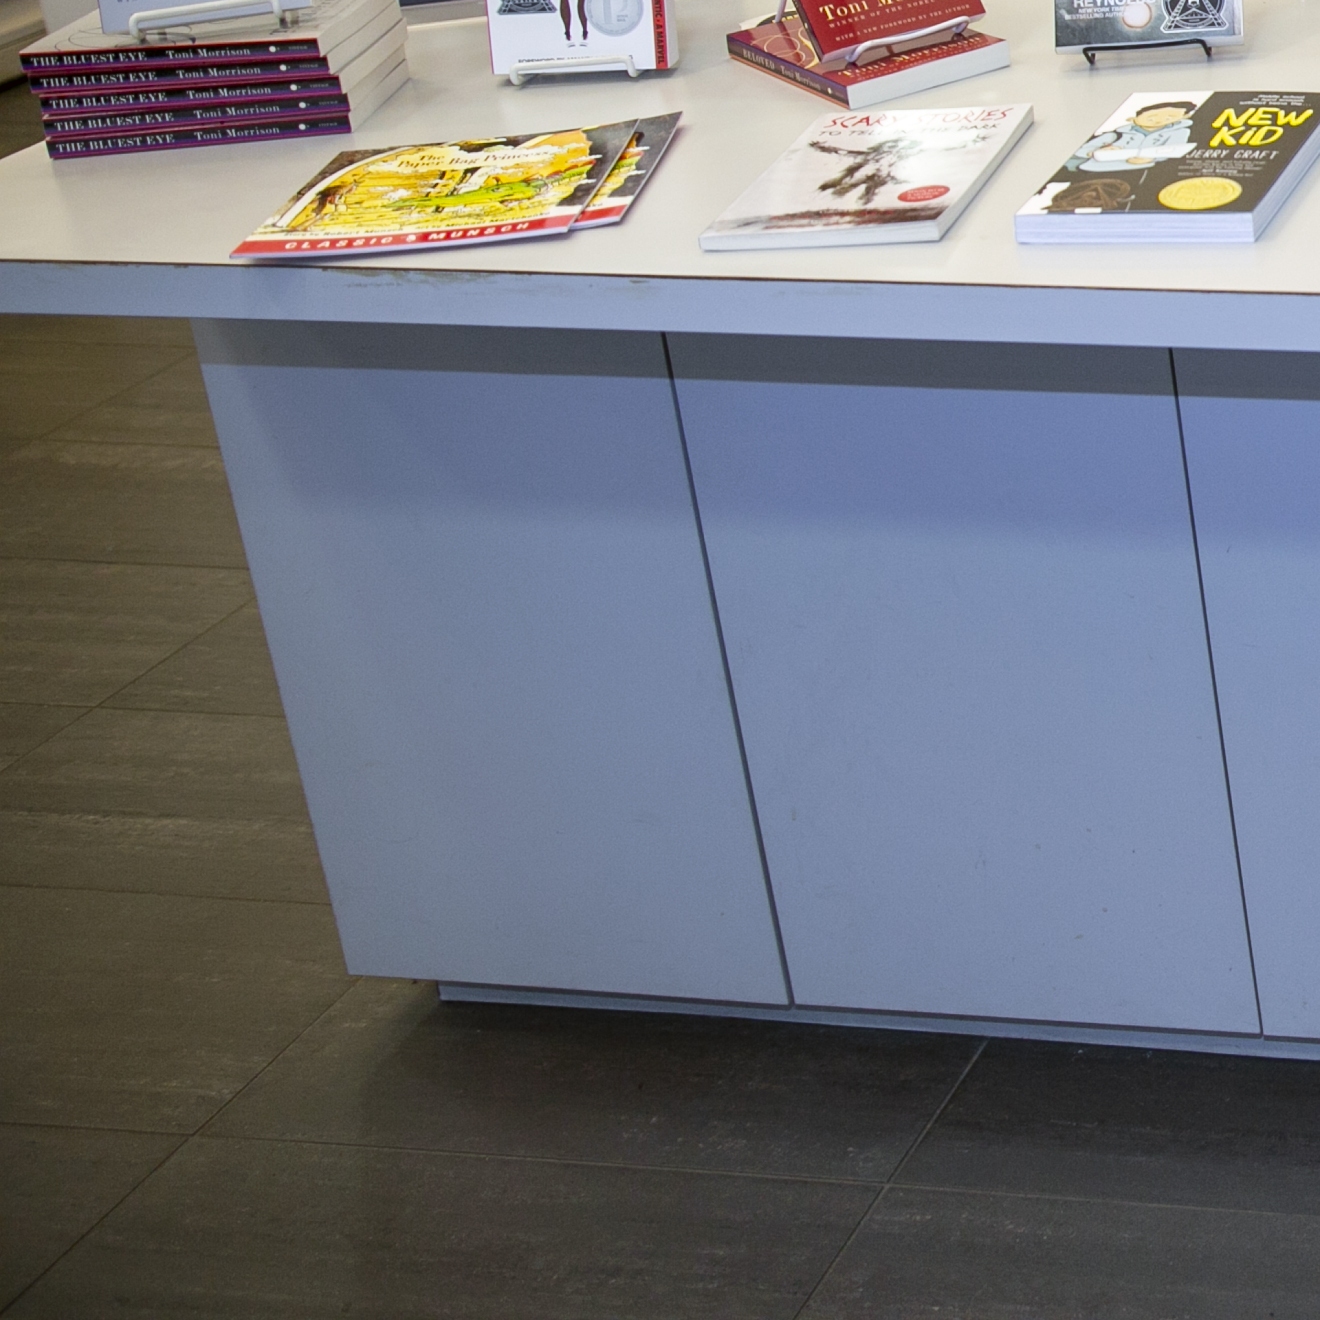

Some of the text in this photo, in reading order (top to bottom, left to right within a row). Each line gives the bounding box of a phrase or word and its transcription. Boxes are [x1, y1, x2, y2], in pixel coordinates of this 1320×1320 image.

[31, 46, 252, 68] THE BLUEST EYE Toni Morrison
[1211, 107, 1314, 128] NEW
[397, 150, 550, 169] Paper Bag Princess
[419, 154, 445, 162] The
[1186, 149, 1280, 160] JERRY CRAFT
[285, 235, 394, 250] CLASSIC
[428, 222, 530, 242] MUNSCH
